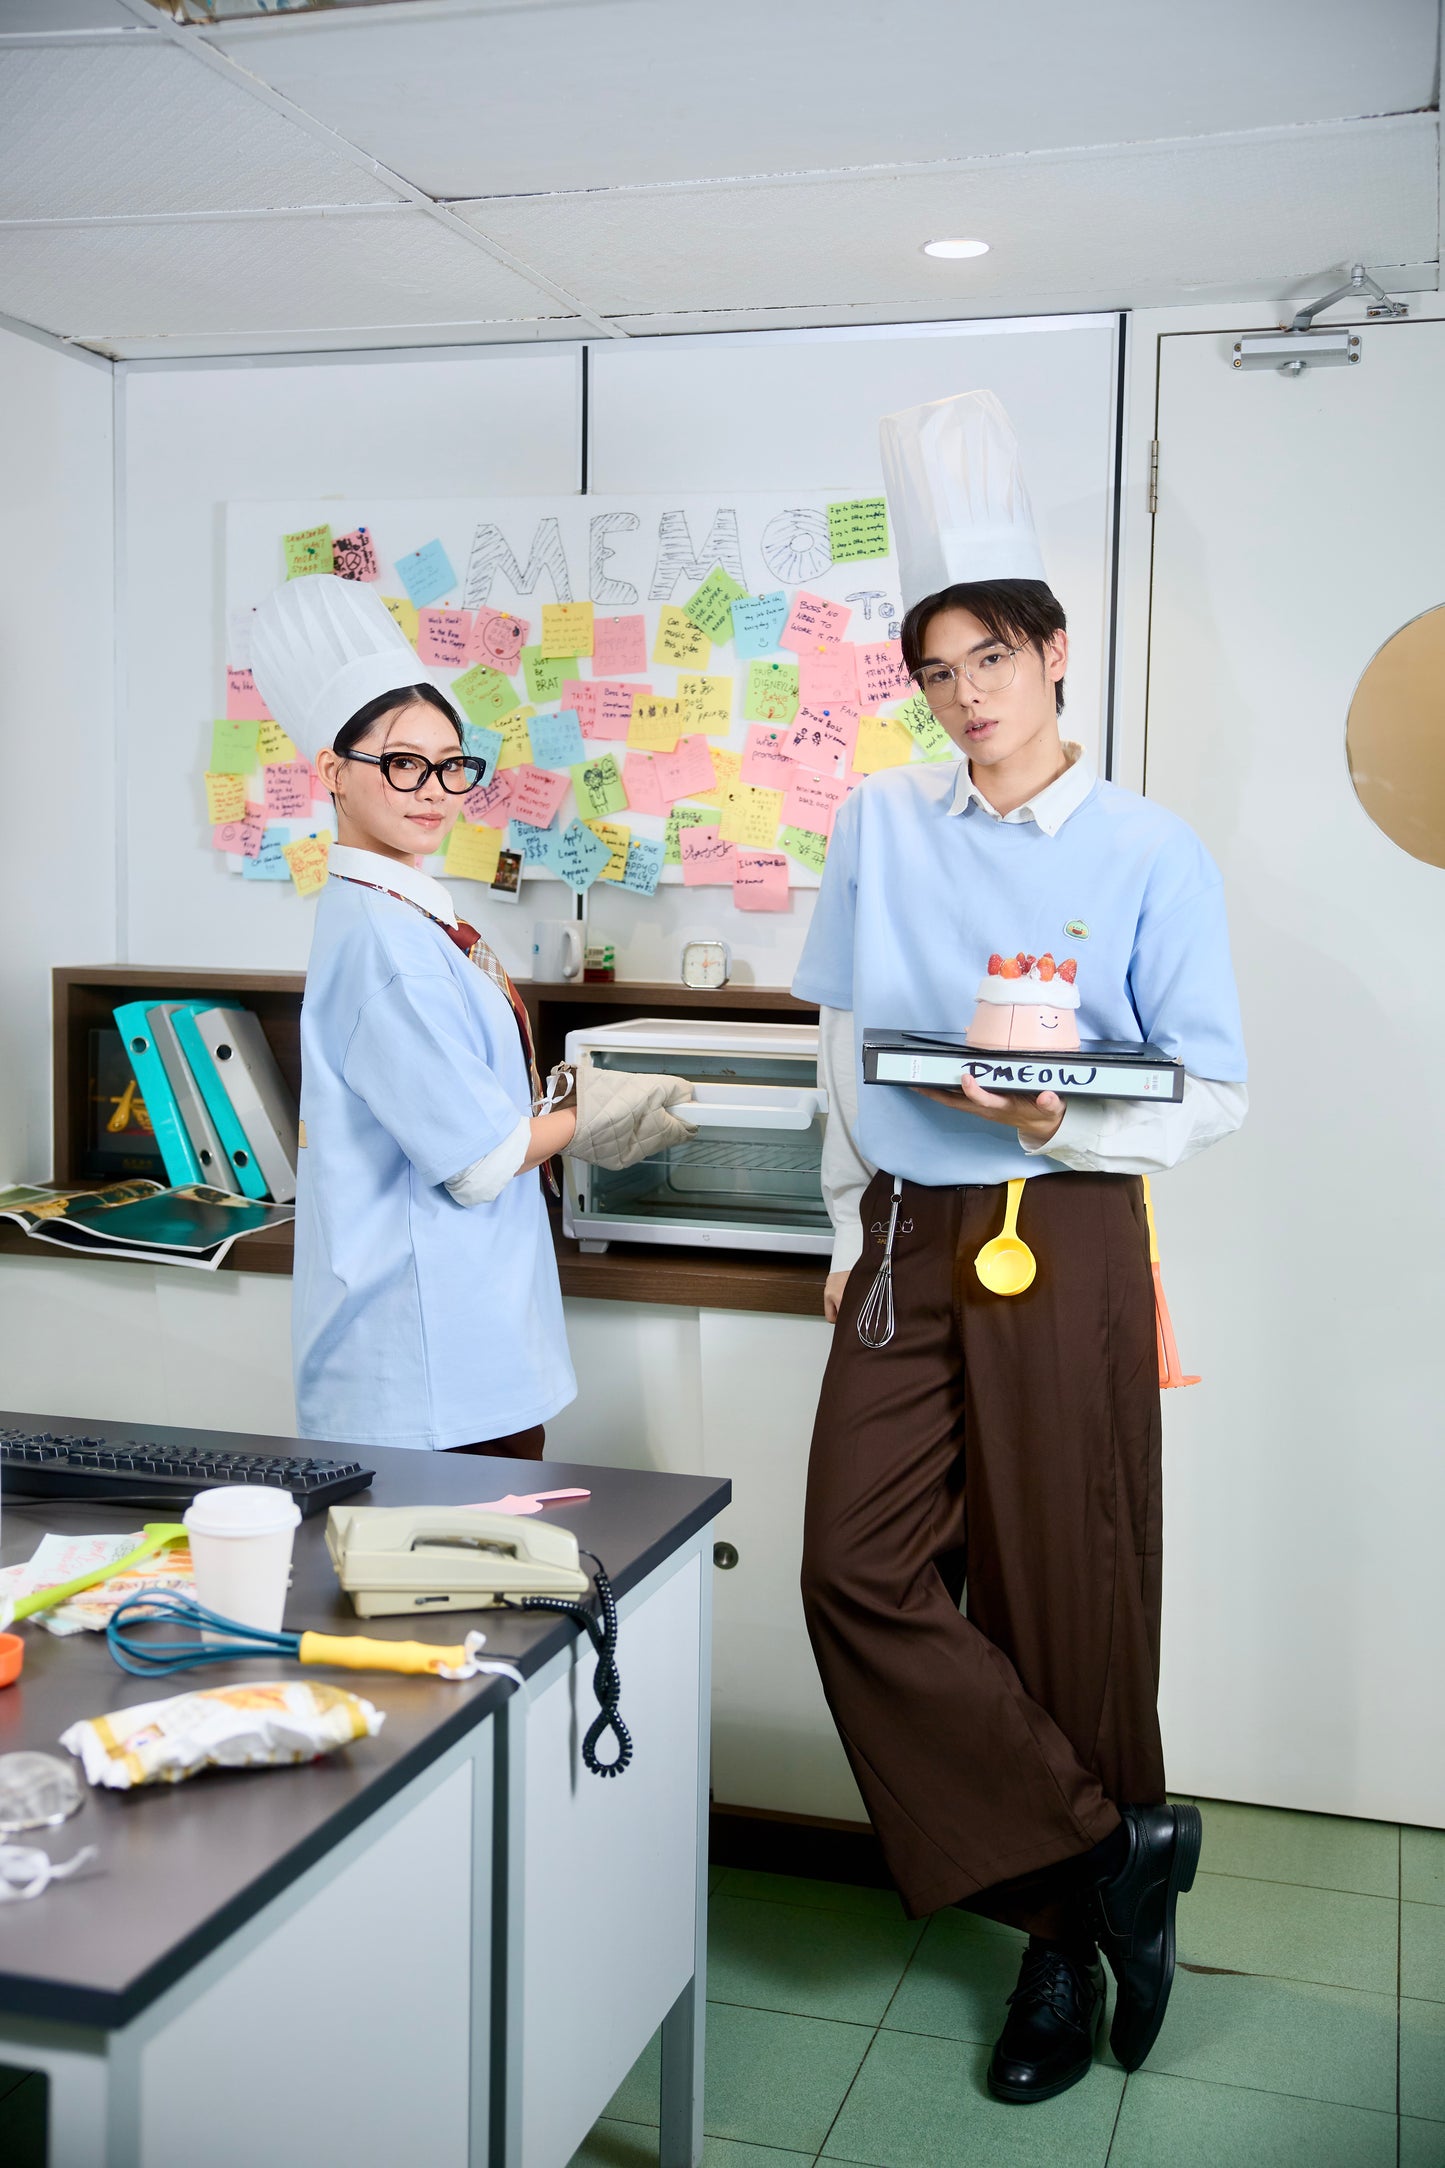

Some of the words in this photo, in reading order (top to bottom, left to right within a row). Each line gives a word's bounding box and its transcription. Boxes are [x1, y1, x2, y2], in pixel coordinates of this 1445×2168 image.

[462, 506, 838, 609] MEMO
[688, 598, 703, 615] GIVE
[702, 585, 712, 596] ME
[795, 612, 816, 624] NEED
[820, 619, 832, 629] TO
[826, 610, 839, 618] NO
[535, 677, 559, 692] BRAT
[756, 735, 779, 748] when
[563, 831, 583, 847] Apply
[626, 863, 648, 873] APPY
[960, 1060, 1098, 1087] DMEOW
